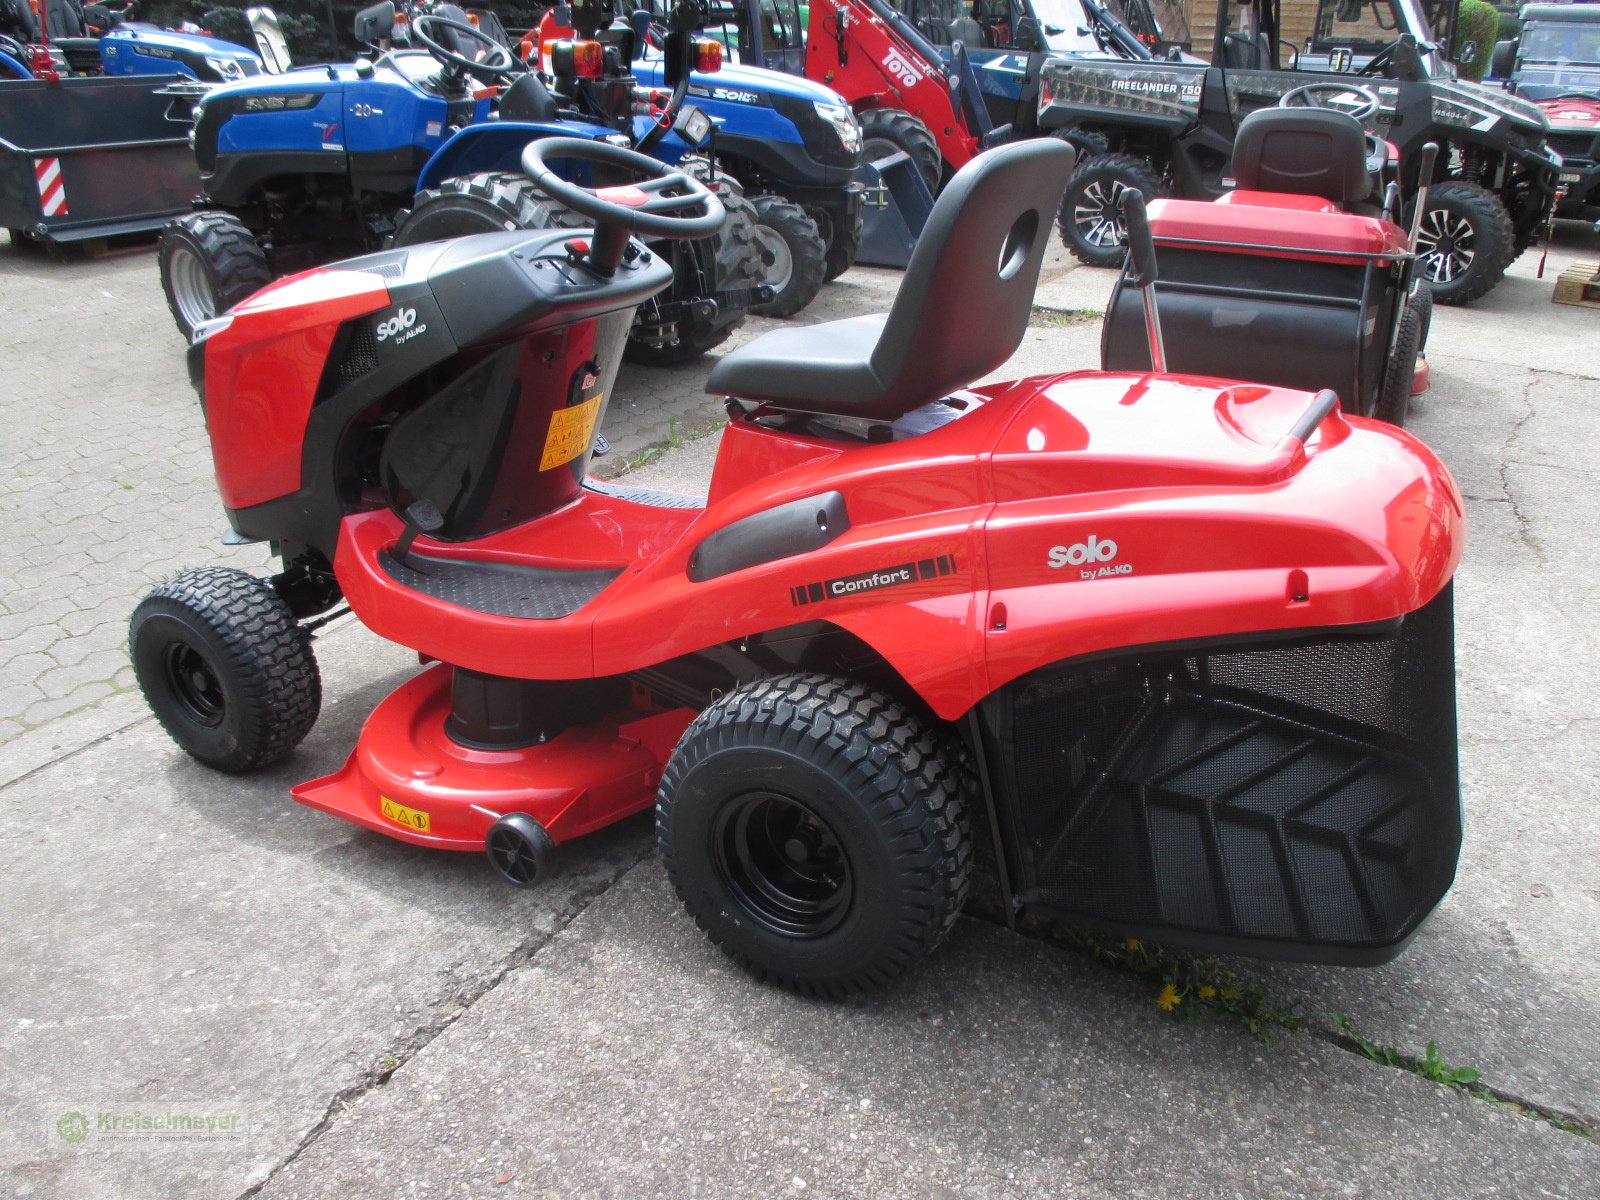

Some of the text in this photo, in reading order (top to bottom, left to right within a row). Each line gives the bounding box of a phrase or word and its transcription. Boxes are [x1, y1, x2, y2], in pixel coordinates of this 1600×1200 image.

[882, 46, 923, 87] TOYO
[1111, 80, 1201, 95] FREELANDER 750
[1378, 86, 1399, 95] EPS
[376, 308, 417, 341] solo
[396, 334, 406, 344] by
[1047, 535, 1118, 568] solo
[831, 569, 910, 594] Comfort
[1080, 570, 1097, 580] by
